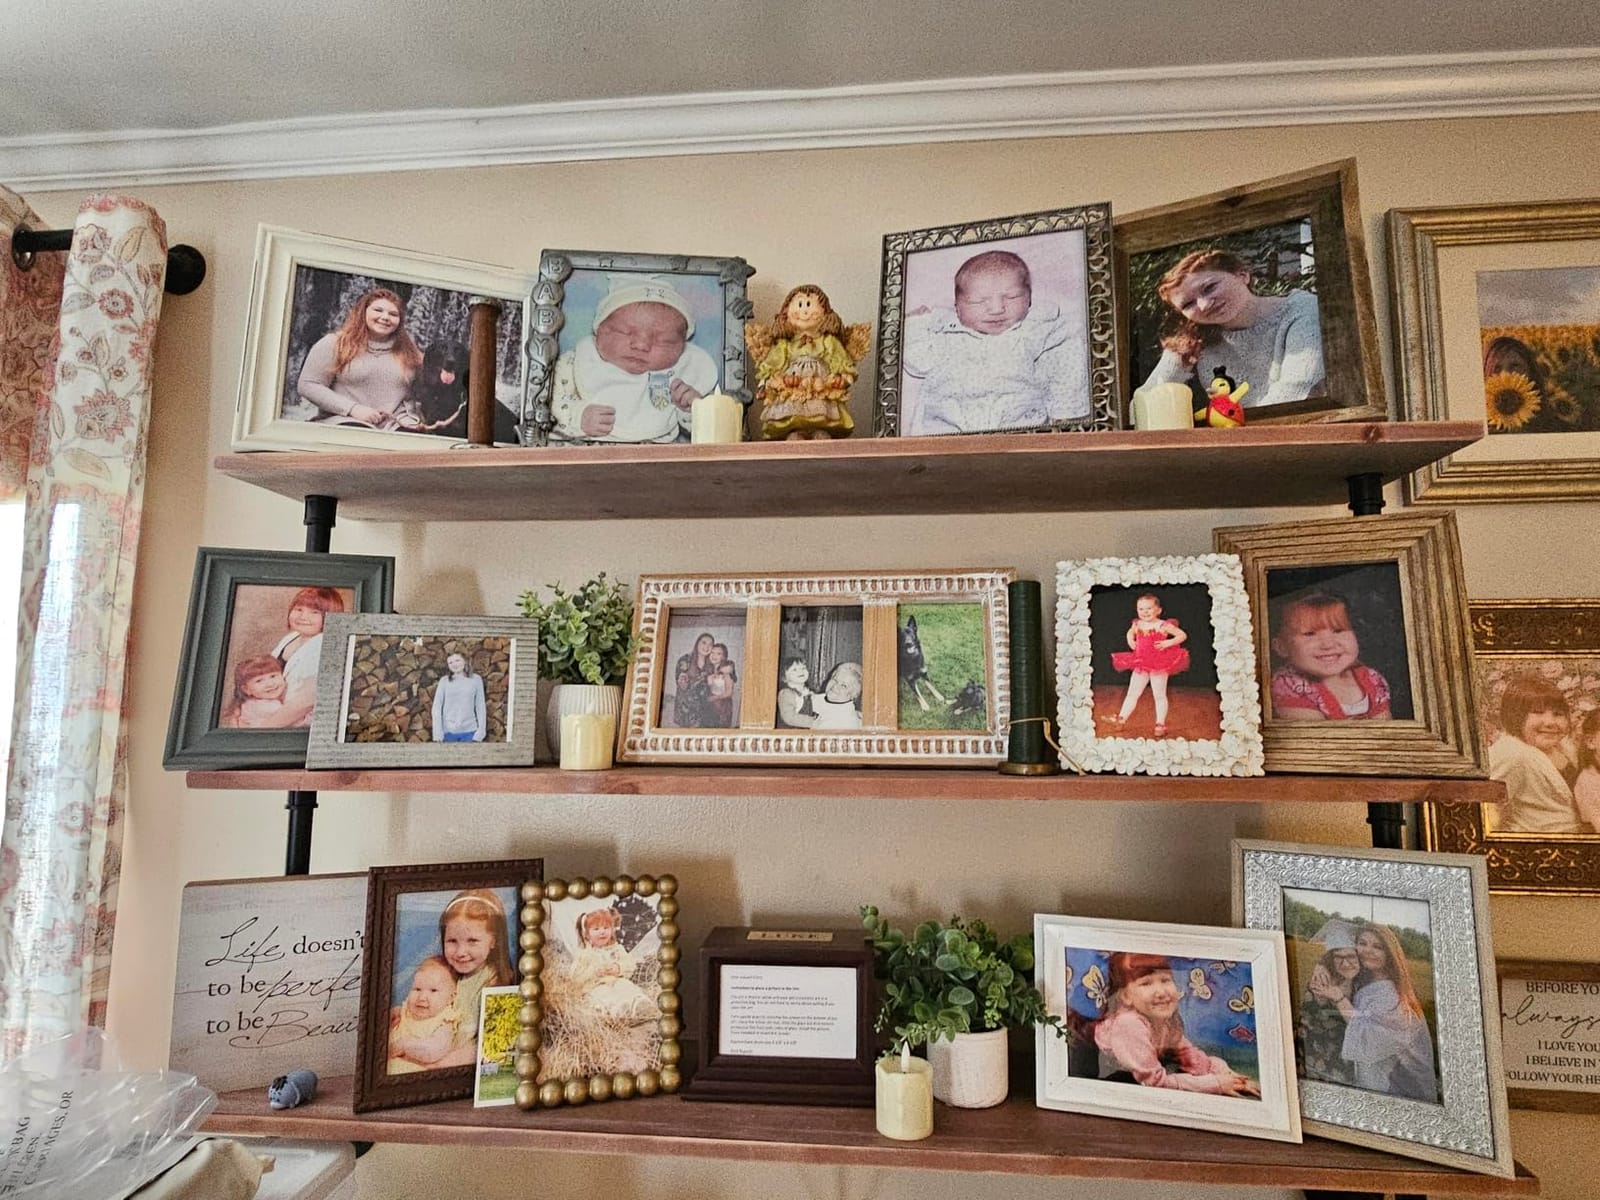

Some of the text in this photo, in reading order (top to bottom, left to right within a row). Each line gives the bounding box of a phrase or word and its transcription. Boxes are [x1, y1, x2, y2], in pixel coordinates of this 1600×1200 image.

[534, 257, 563, 358] BABY
[205, 916, 285, 973] Life
[208, 982, 231, 997] to
[240, 975, 266, 994] be
[1526, 981, 1600, 995] BEFORE YO
[206, 1009, 360, 1048] to be Beau
[1538, 1040, 1600, 1052] I LOVE YOU
[1526, 1055, 1529, 1065] I
[1532, 1055, 1581, 1068] BELIEVE
[1583, 1058, 1597, 1068] IN
[1505, 1070, 1550, 1082] OLLOW
[1551, 1072, 1583, 1083] YOUR
[11, 1116, 31, 1146] BAG
[24, 1090, 74, 1186] CRIAGES, OR
